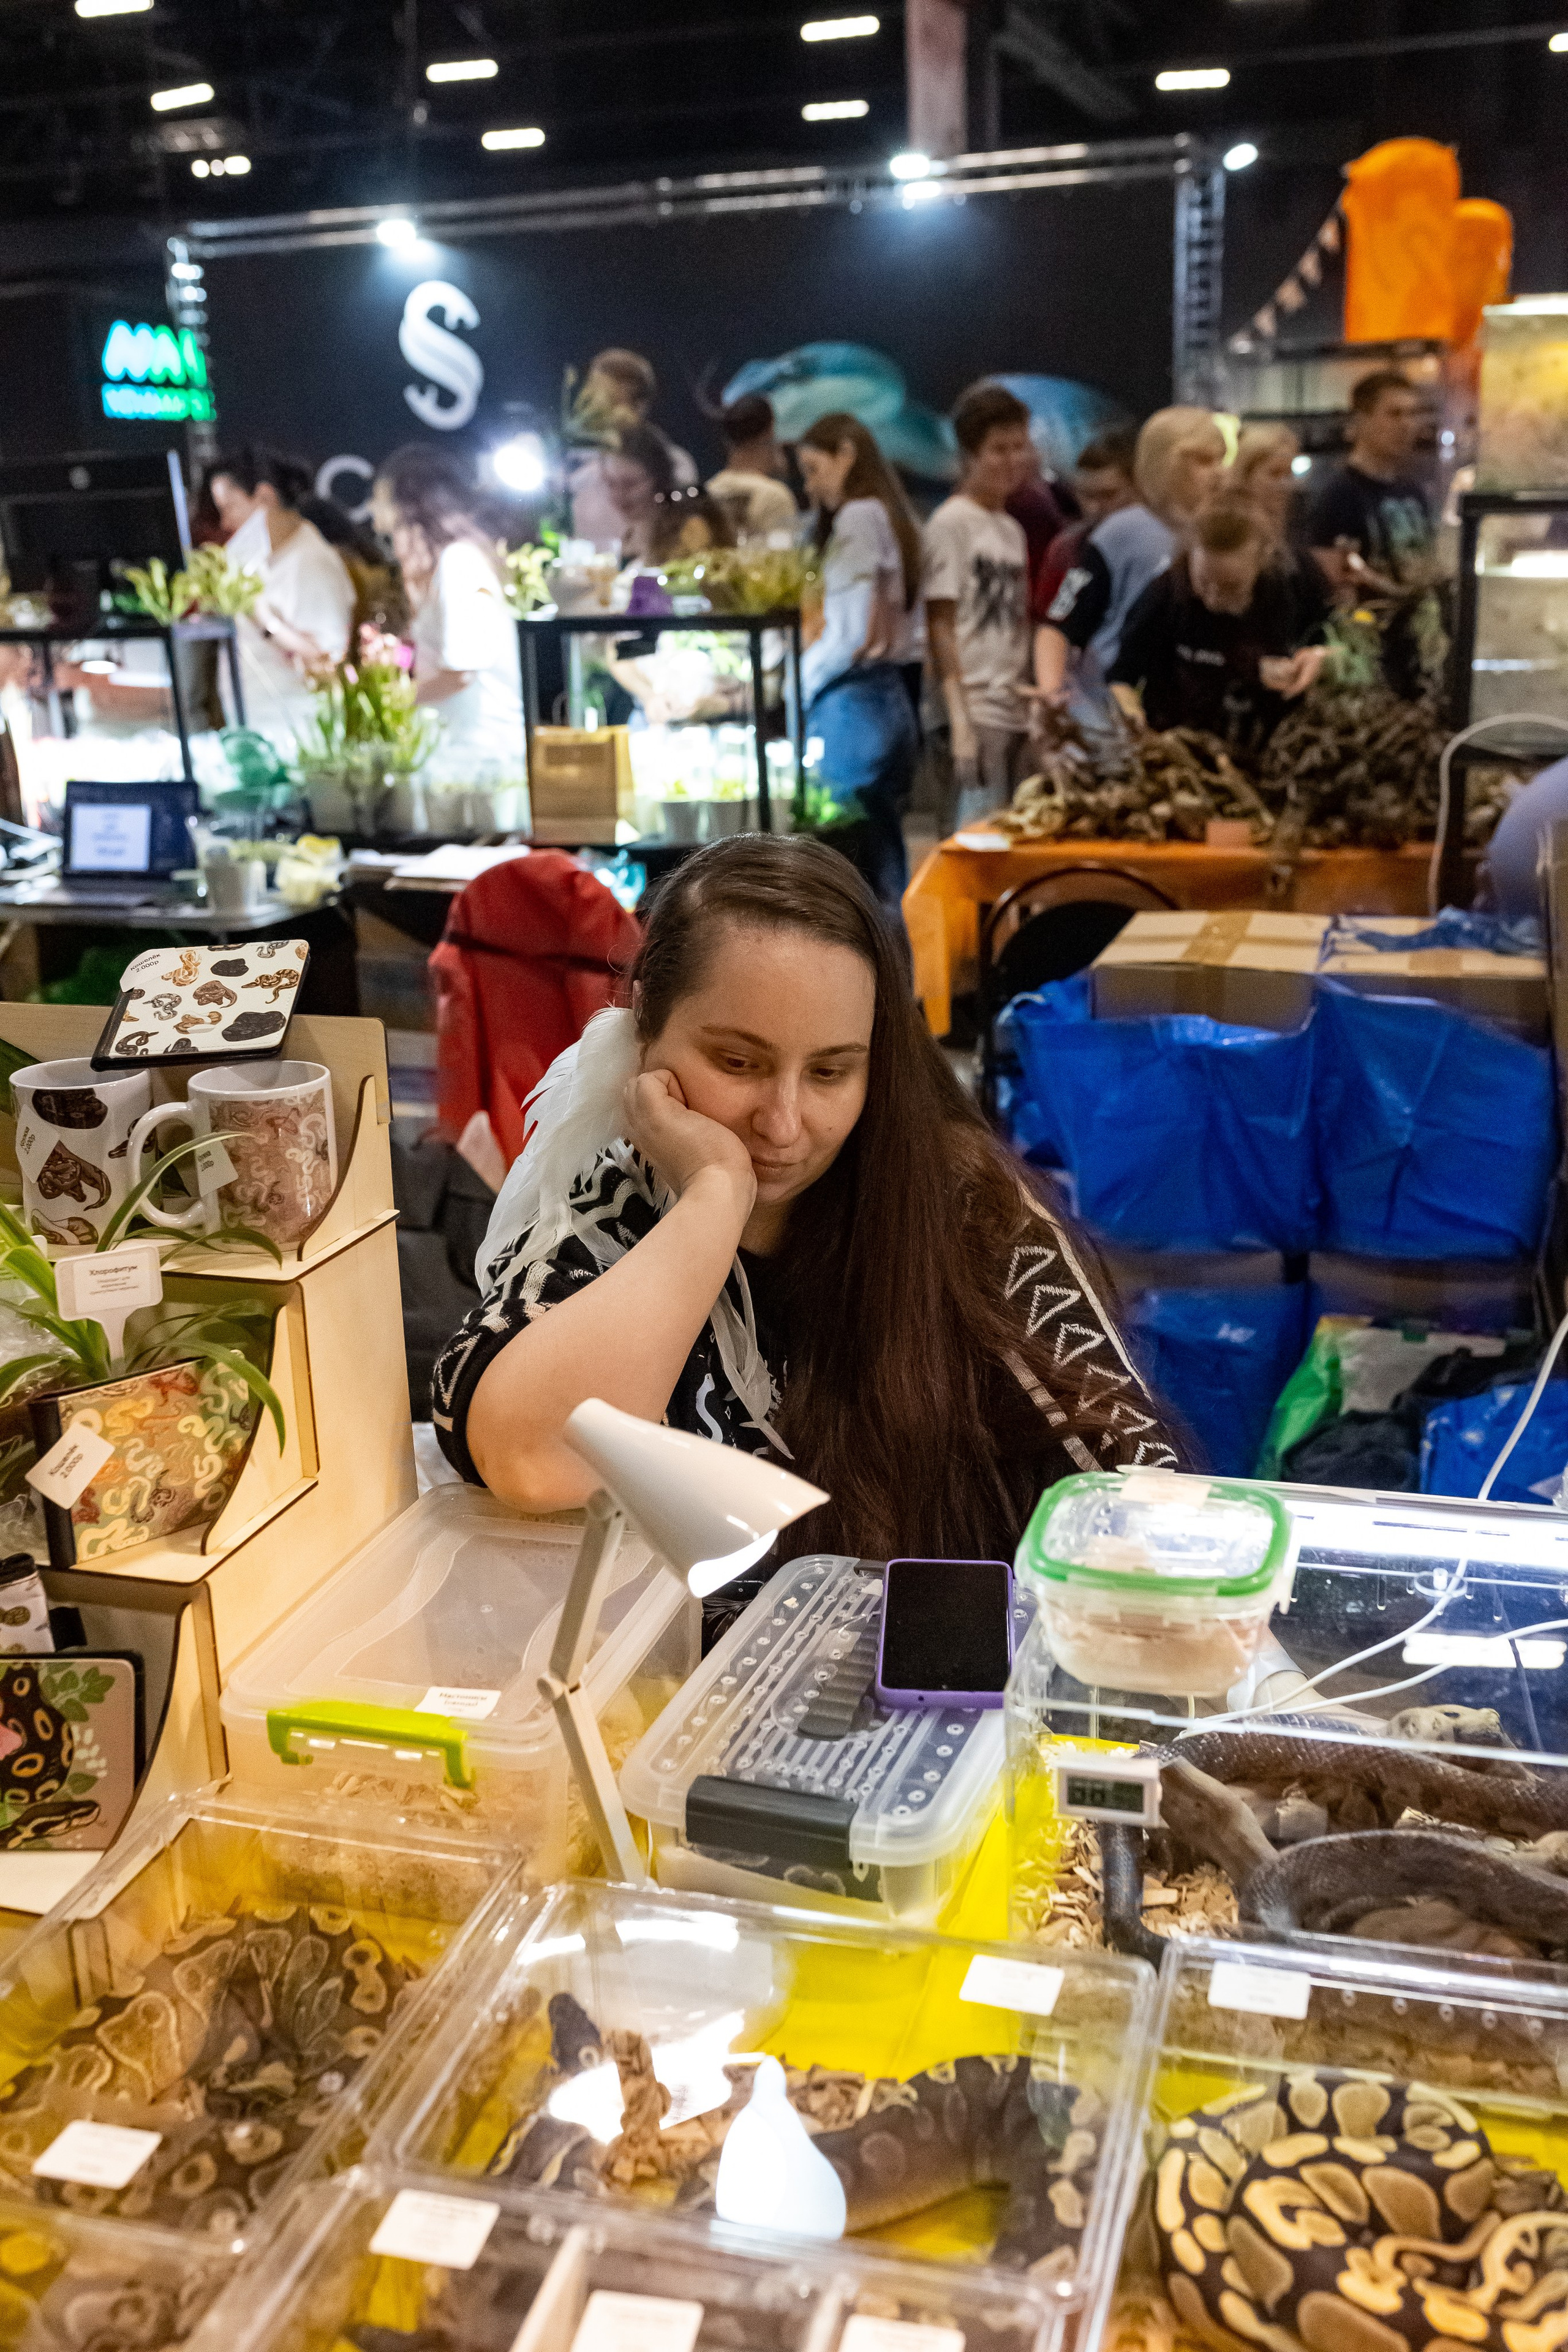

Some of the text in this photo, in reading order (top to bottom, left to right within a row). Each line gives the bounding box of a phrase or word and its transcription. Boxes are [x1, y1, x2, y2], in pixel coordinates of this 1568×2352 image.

[130, 953, 161, 971] Кошелёк
[135, 960, 159, 973] 2.000р
[89, 1265, 138, 1276] Хлорофитум
